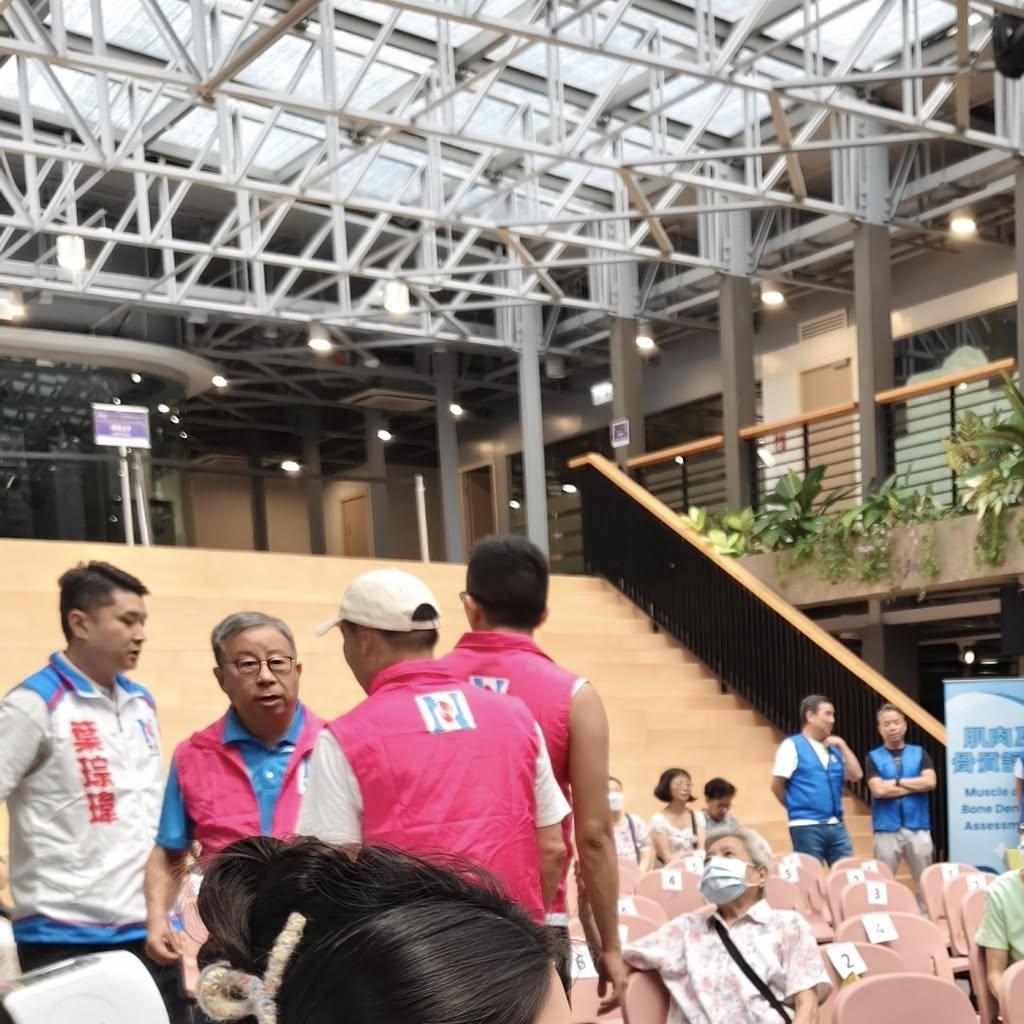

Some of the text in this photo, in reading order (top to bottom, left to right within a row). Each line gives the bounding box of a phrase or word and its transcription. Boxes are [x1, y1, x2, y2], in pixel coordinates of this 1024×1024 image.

[964, 787, 1009, 798] Muscle
[961, 803, 1019, 815] Bone Den
[964, 821, 1020, 831] Assessm
[872, 887, 882, 900] 3
[840, 953, 855, 969] 2
